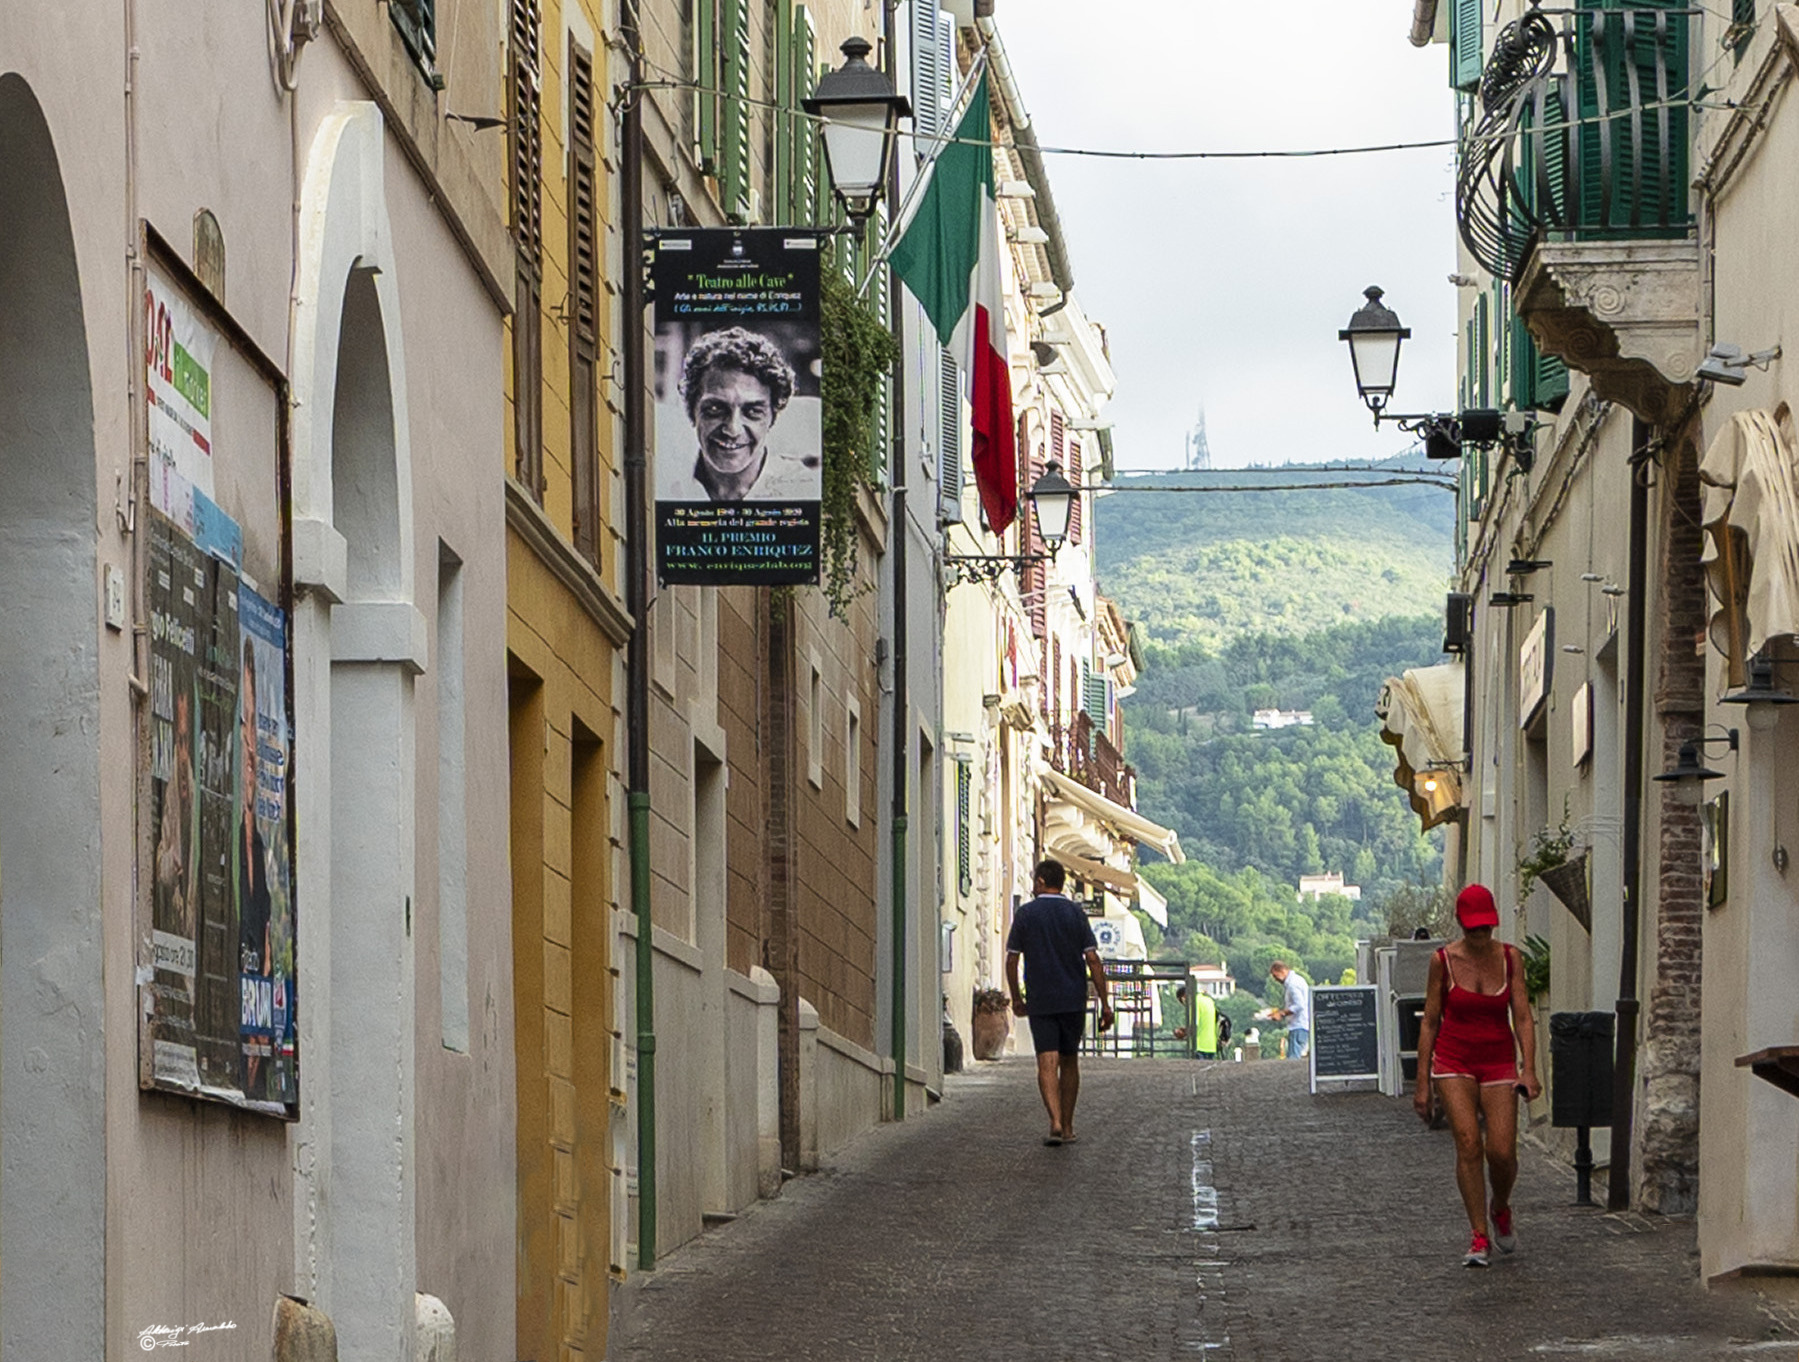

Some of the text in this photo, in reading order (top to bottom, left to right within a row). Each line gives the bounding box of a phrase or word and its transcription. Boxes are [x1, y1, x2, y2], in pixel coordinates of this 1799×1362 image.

[735, 272, 758, 288] alle
[724, 291, 735, 301] nel
[759, 291, 767, 301] di
[664, 517, 809, 528] Alla memoria del grande regista
[701, 532, 776, 543] IL PREMIO
[665, 544, 813, 558] FRANCO ENRIQUEZ
